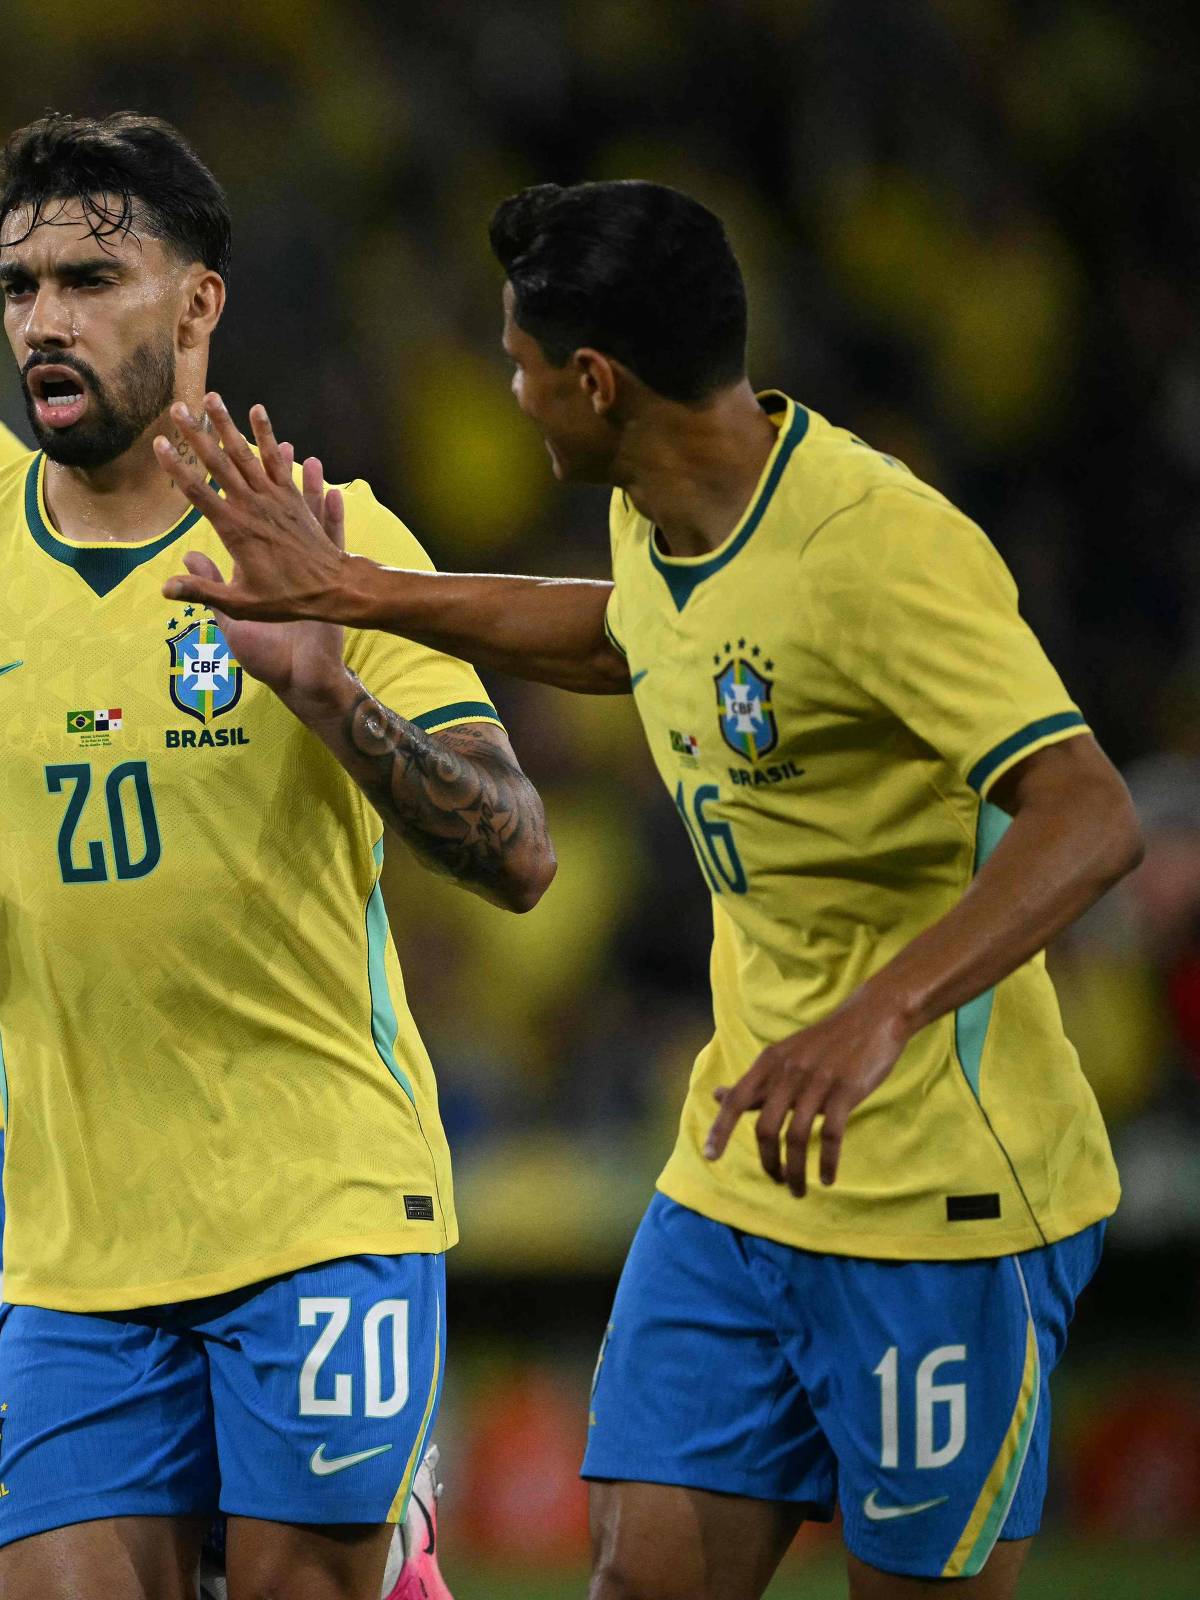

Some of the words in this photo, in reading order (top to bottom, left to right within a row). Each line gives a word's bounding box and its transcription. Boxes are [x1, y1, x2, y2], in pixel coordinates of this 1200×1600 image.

[190, 660, 221, 673] CBF
[165, 727, 250, 748] BRASIL
[729, 762, 804, 785] BRASIL
[44, 760, 162, 885] 20
[676, 781, 748, 894] 16
[299, 1296, 410, 1418] 20
[873, 1343, 967, 1470] 16
